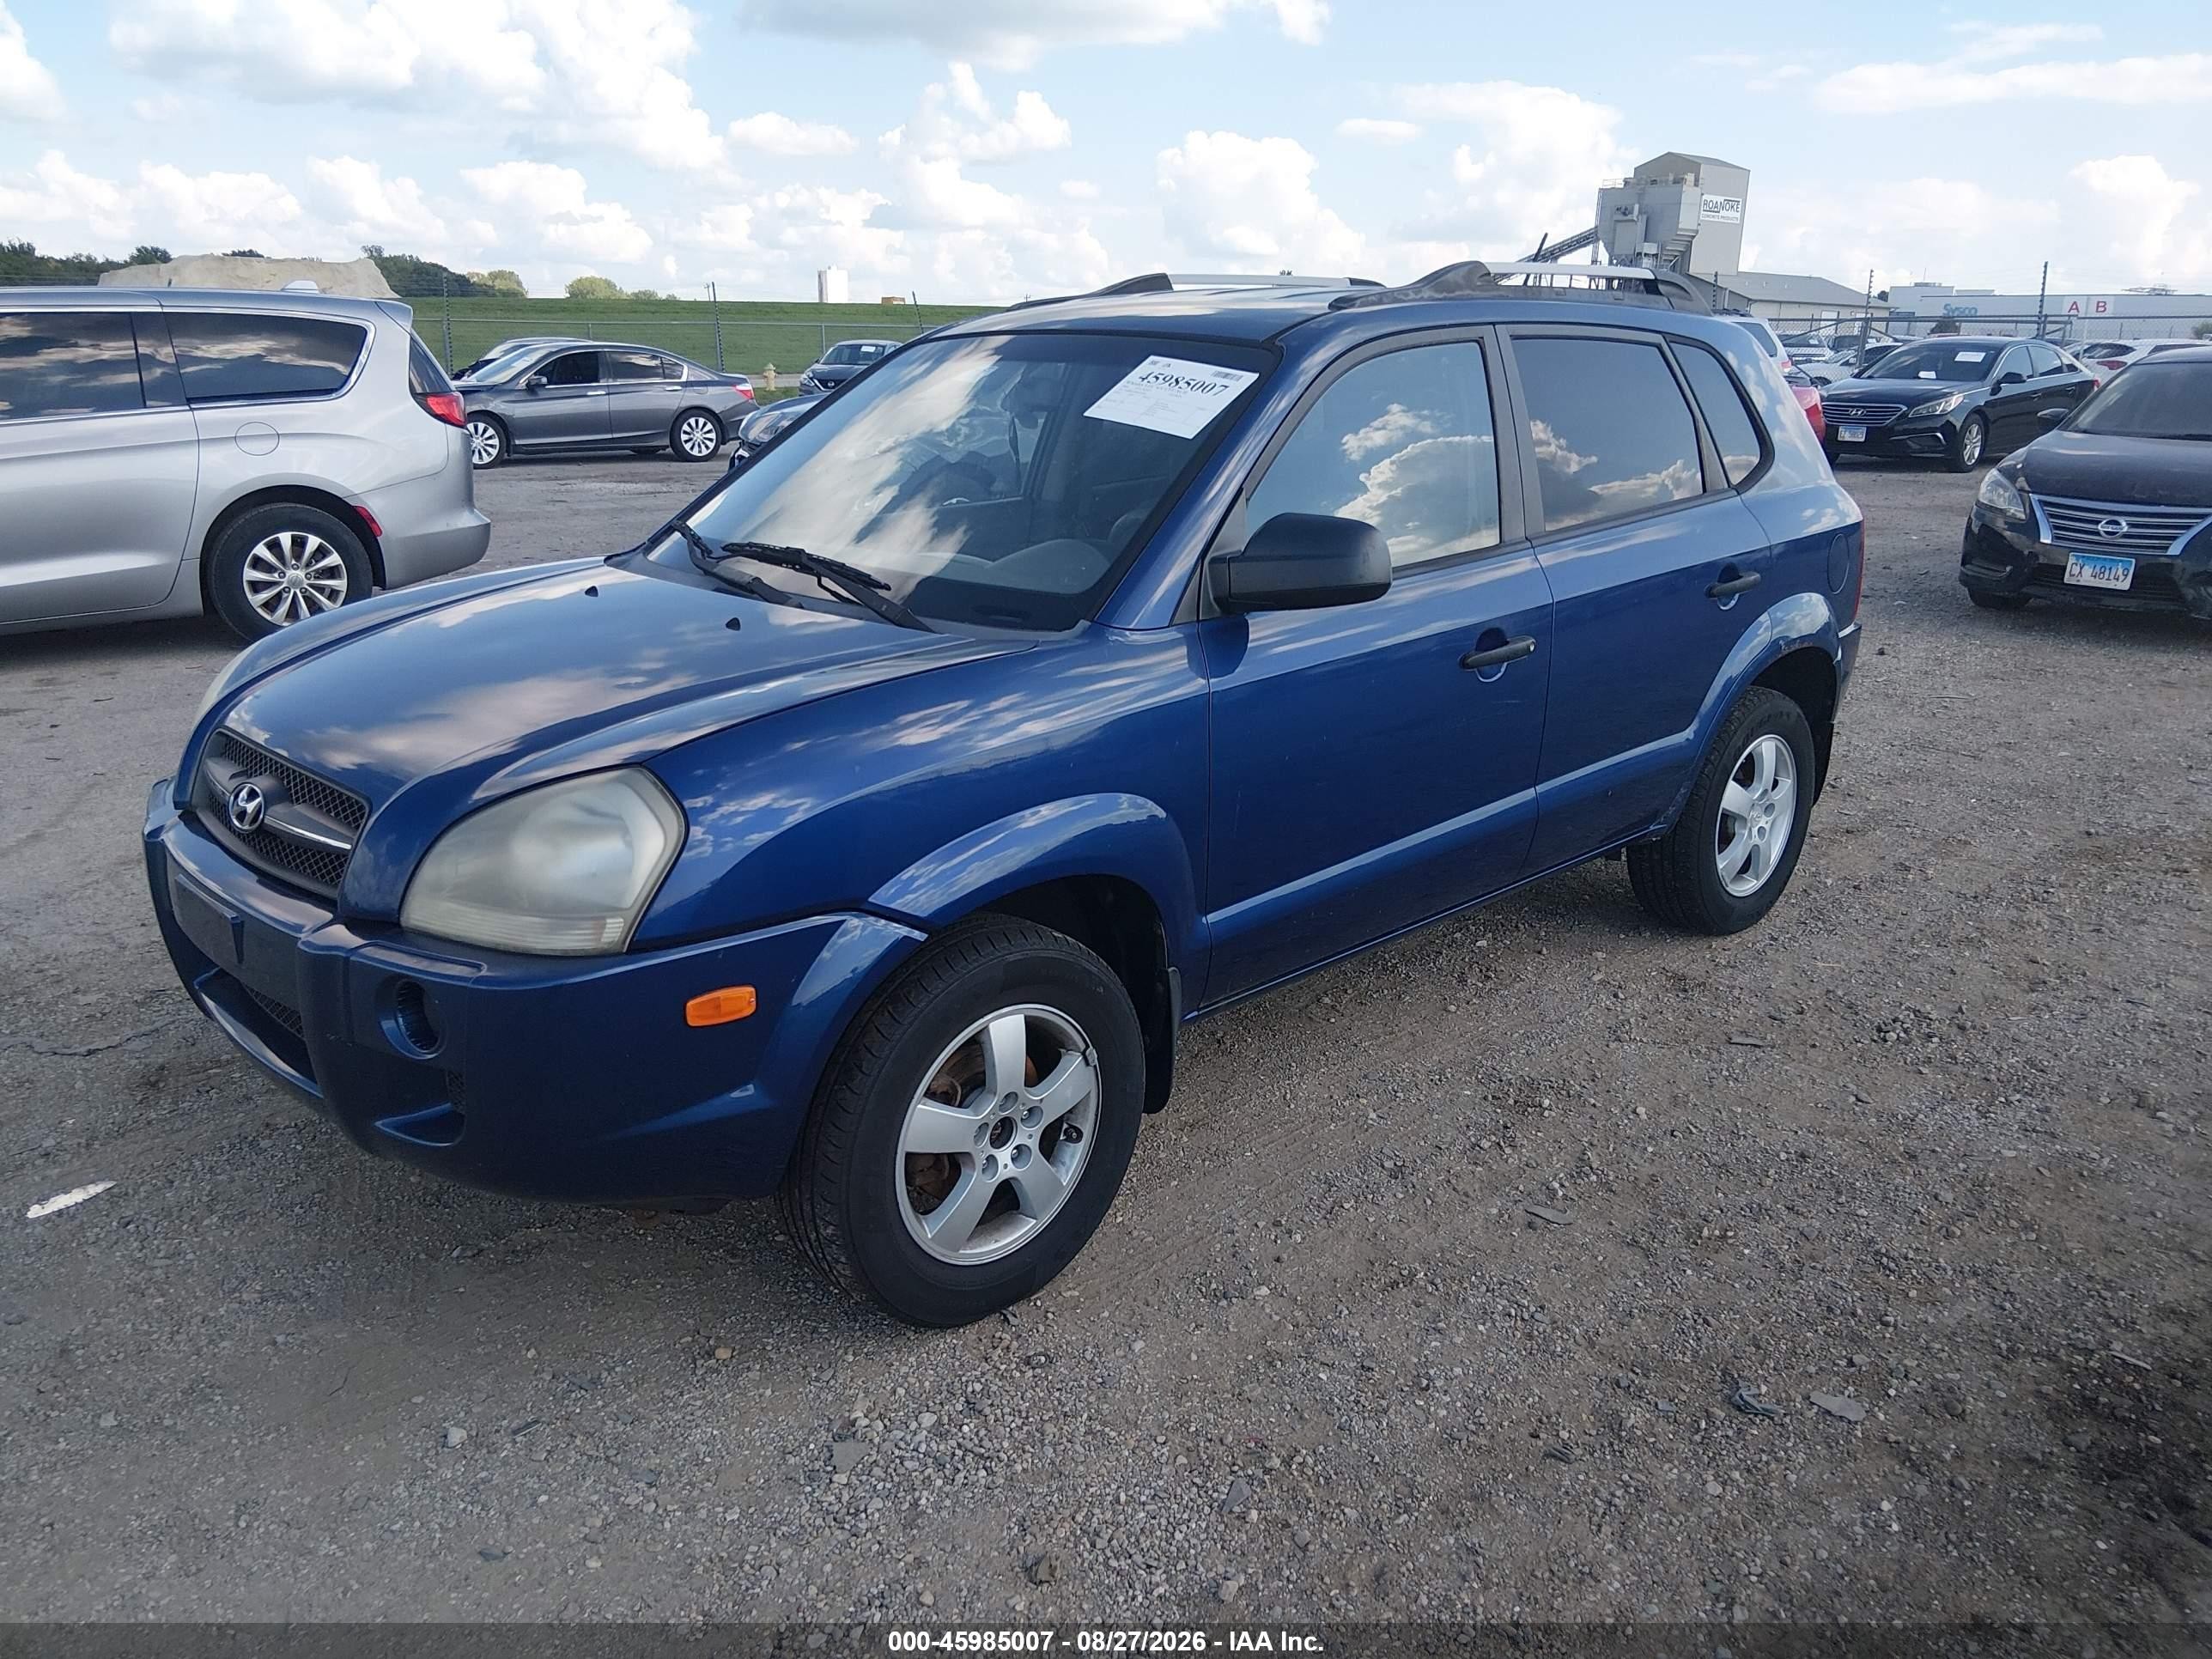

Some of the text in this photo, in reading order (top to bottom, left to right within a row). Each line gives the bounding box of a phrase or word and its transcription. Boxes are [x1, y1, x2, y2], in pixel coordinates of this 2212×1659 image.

[1703, 199, 1741, 213] ROANOKE
[1942, 303, 1978, 317] Sysco
[2068, 301, 2107, 313] A B
[1139, 371, 1230, 397] 45985007
[2069, 562, 2130, 583] CX 48149
